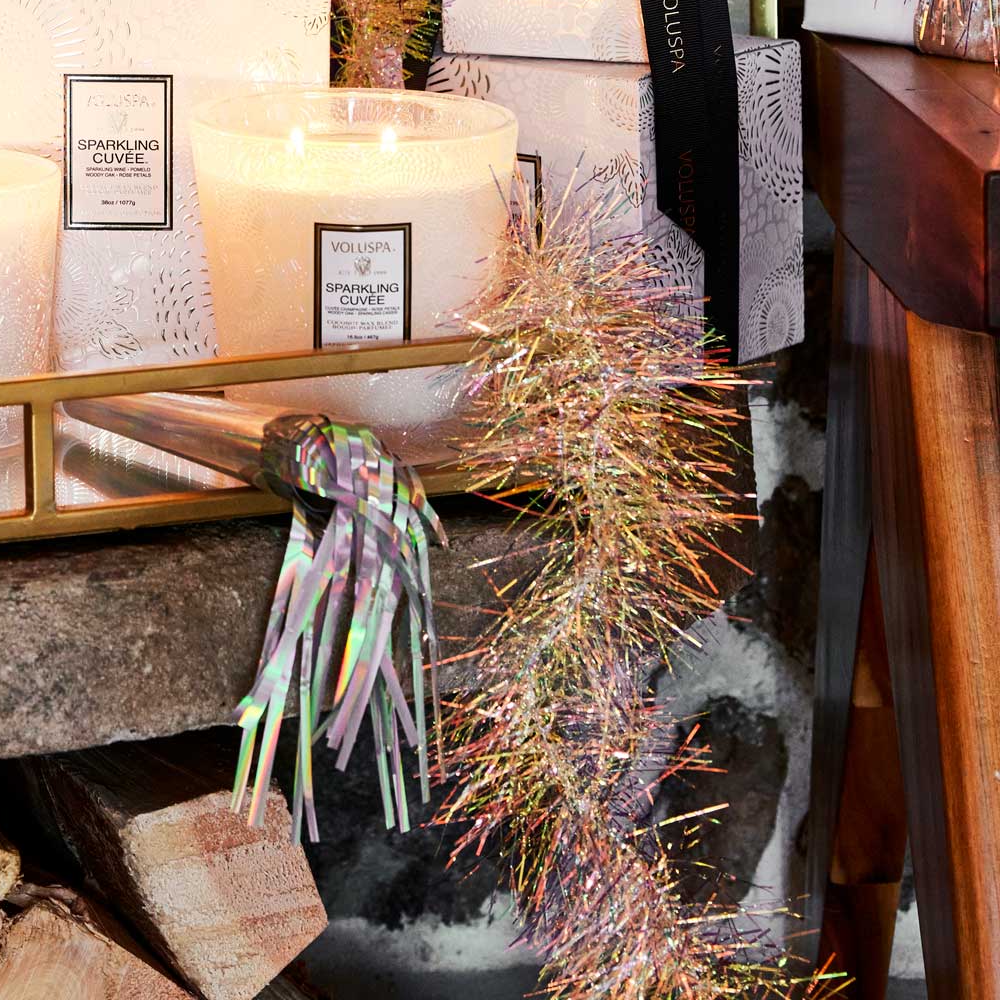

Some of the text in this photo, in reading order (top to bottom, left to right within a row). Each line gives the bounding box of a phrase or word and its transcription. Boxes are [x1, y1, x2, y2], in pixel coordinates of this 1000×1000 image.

[77, 139, 160, 151] SPARKLING
[92, 150, 145, 164] CUVÉE
[331, 241, 391, 254] VOLUSPA
[325, 282, 399, 294] SPARKLING
[340, 294, 385, 305] CUVÉE
